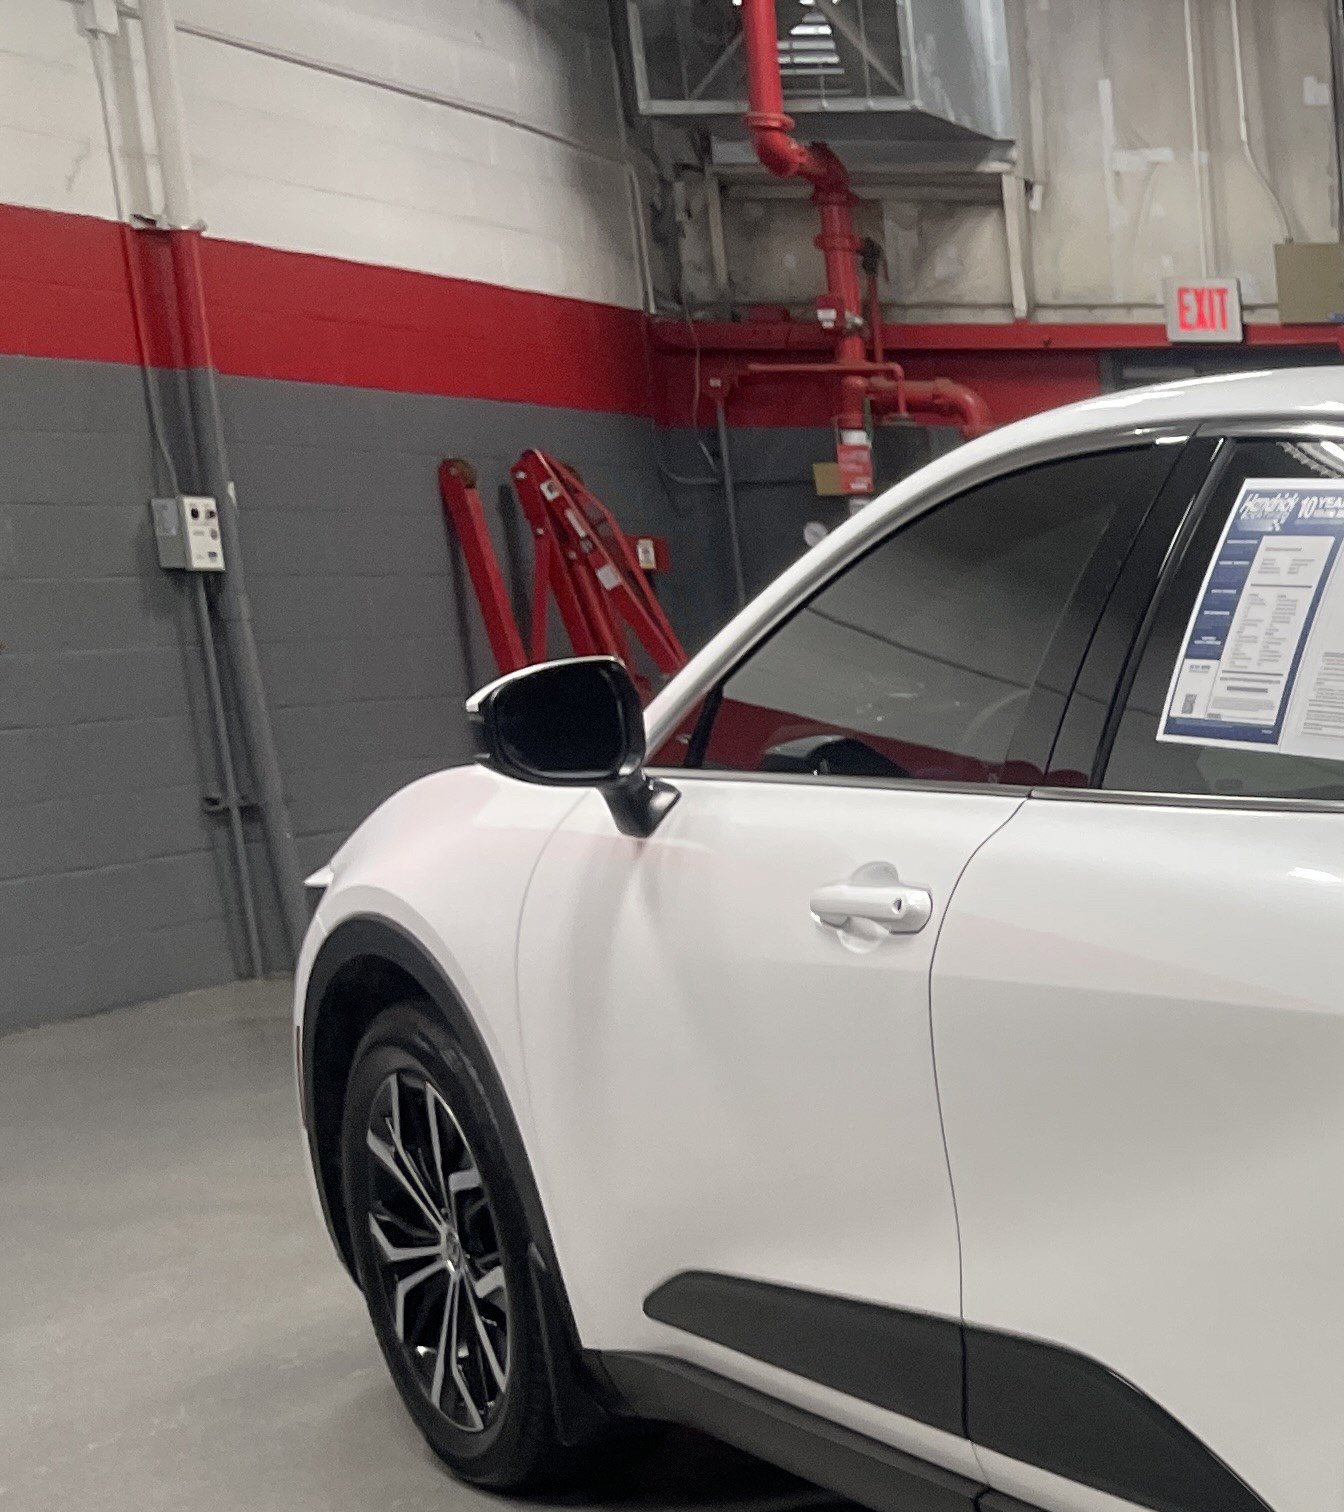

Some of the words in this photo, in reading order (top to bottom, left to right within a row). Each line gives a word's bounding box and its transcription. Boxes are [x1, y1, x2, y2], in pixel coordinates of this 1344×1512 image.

[1177, 286, 1228, 332] EXIT
[1238, 492, 1299, 519] Hendrick
[1298, 496, 1318, 519] 10
